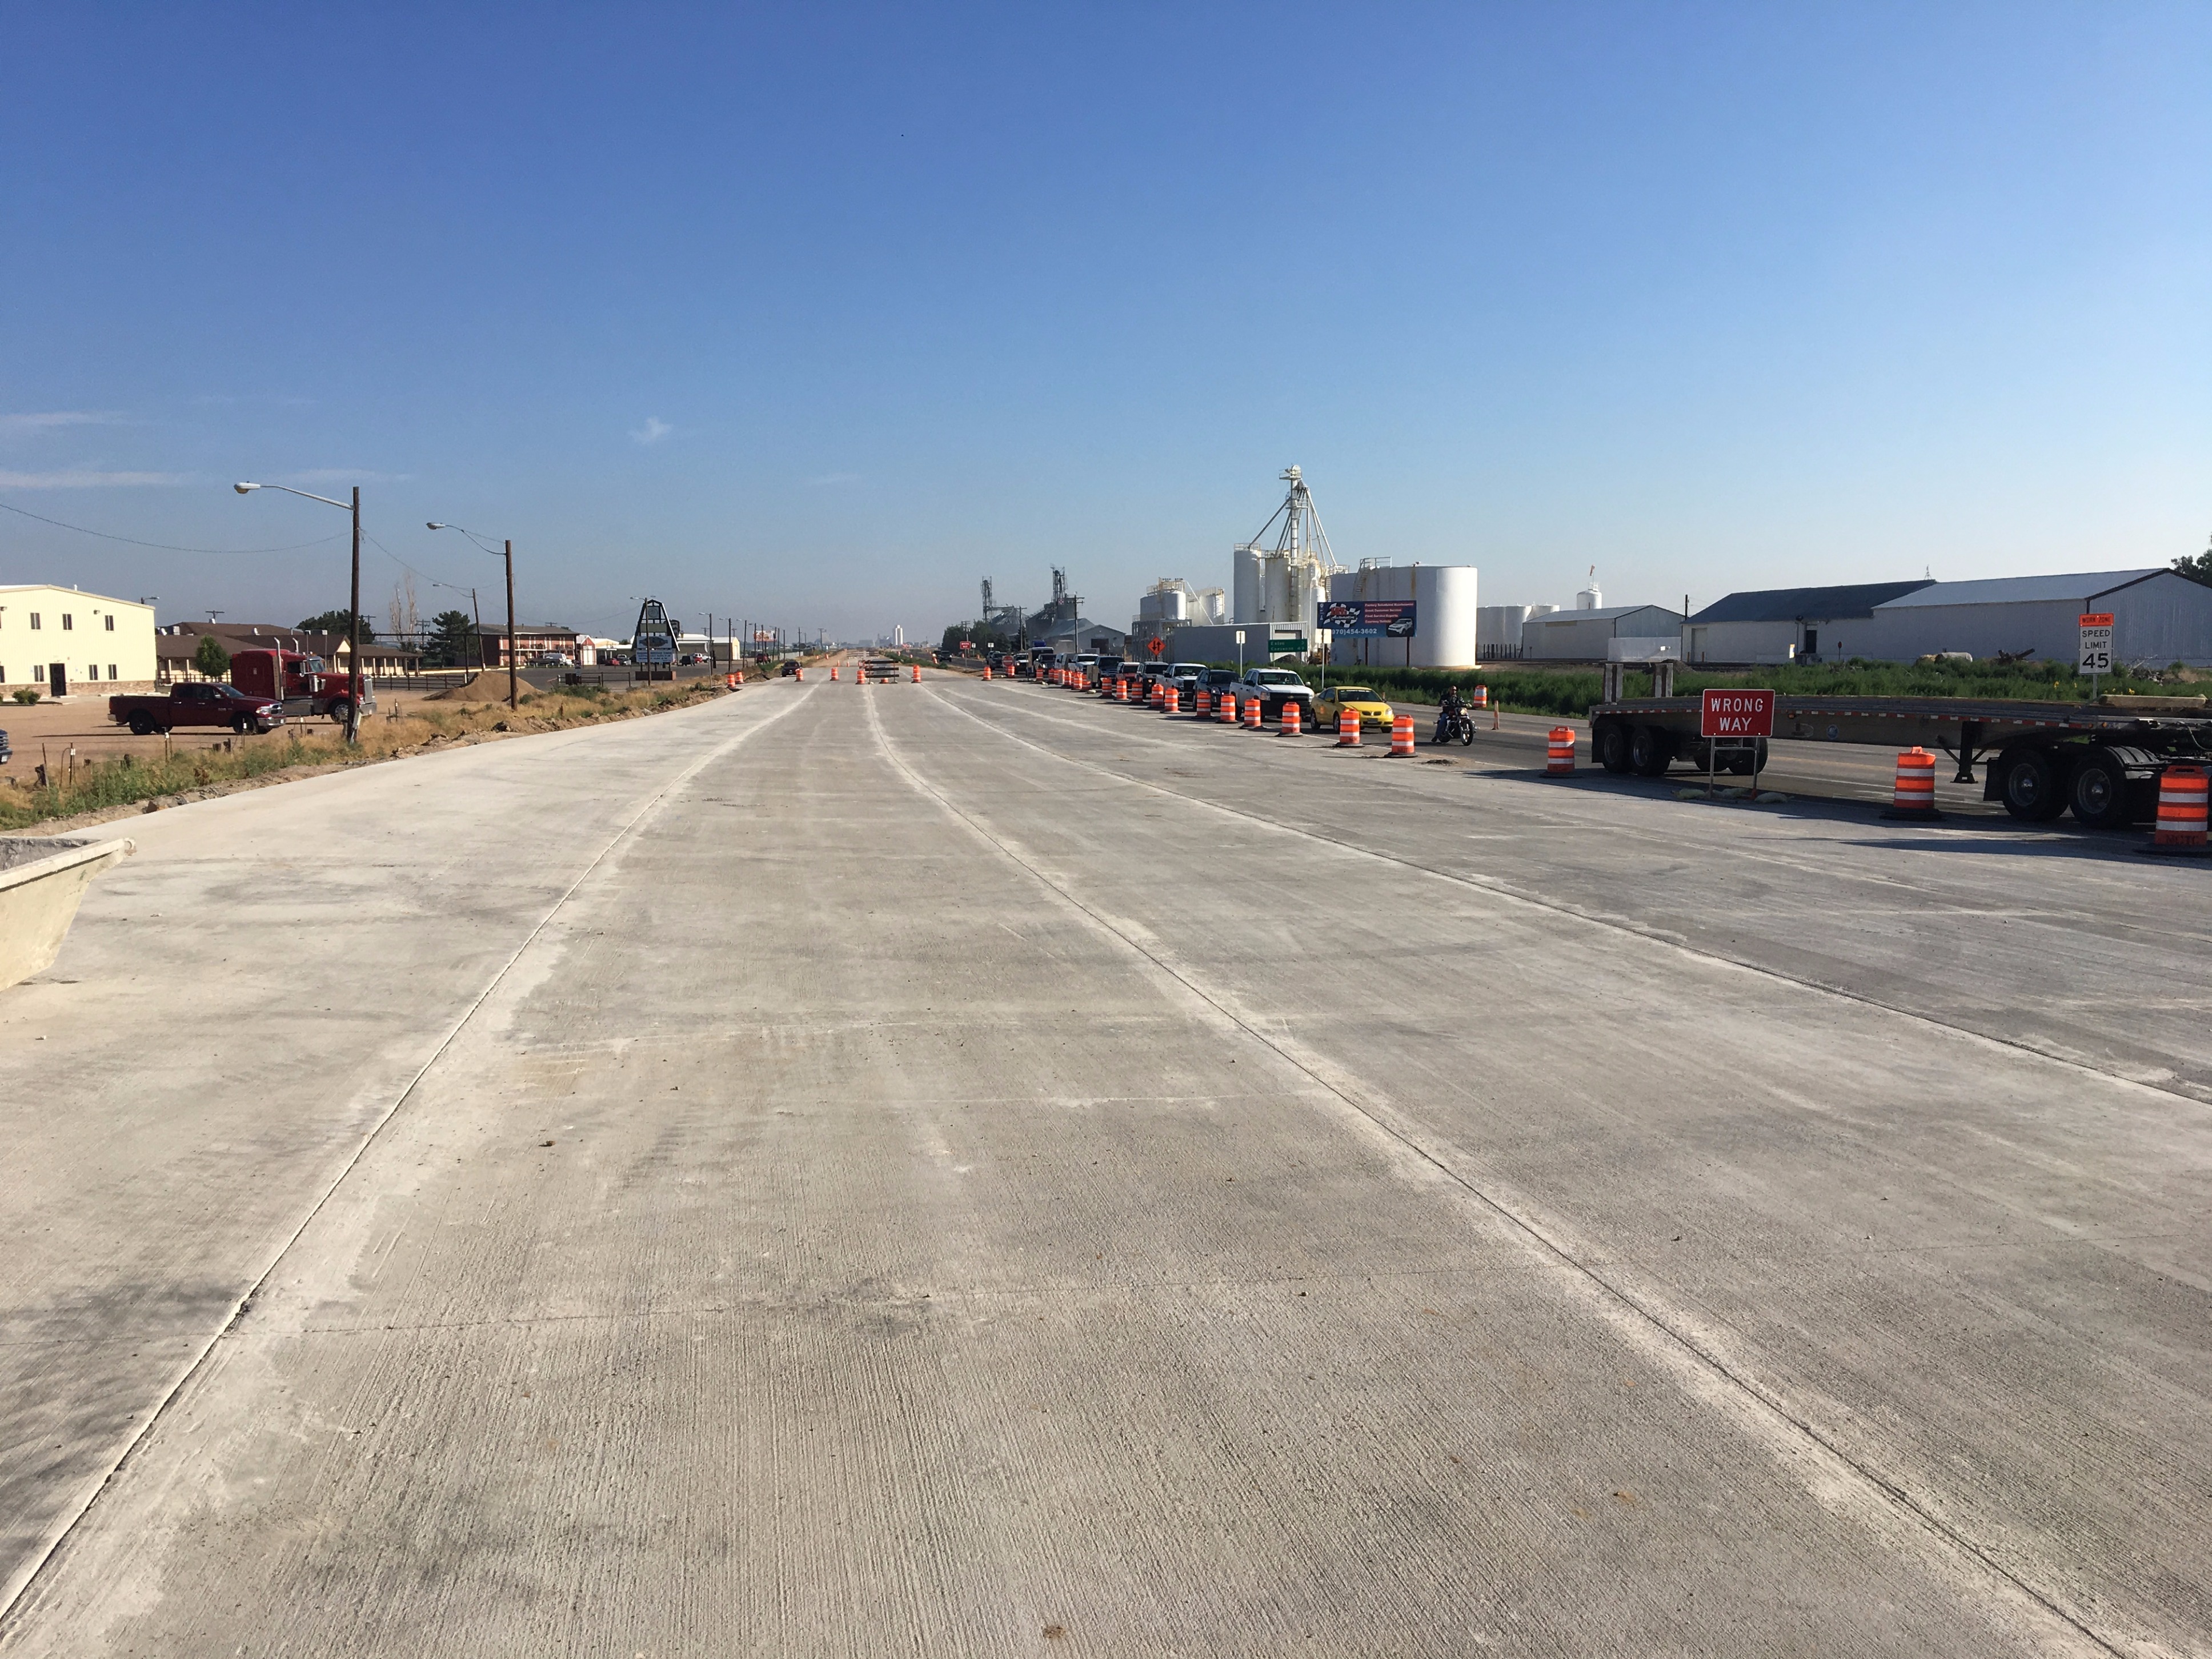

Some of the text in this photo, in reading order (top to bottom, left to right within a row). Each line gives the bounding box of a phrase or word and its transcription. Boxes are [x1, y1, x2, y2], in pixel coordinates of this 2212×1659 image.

[2082, 652, 2109, 668] 45
[1711, 698, 1763, 712] WRONG
[1720, 718, 1752, 731] WAY
